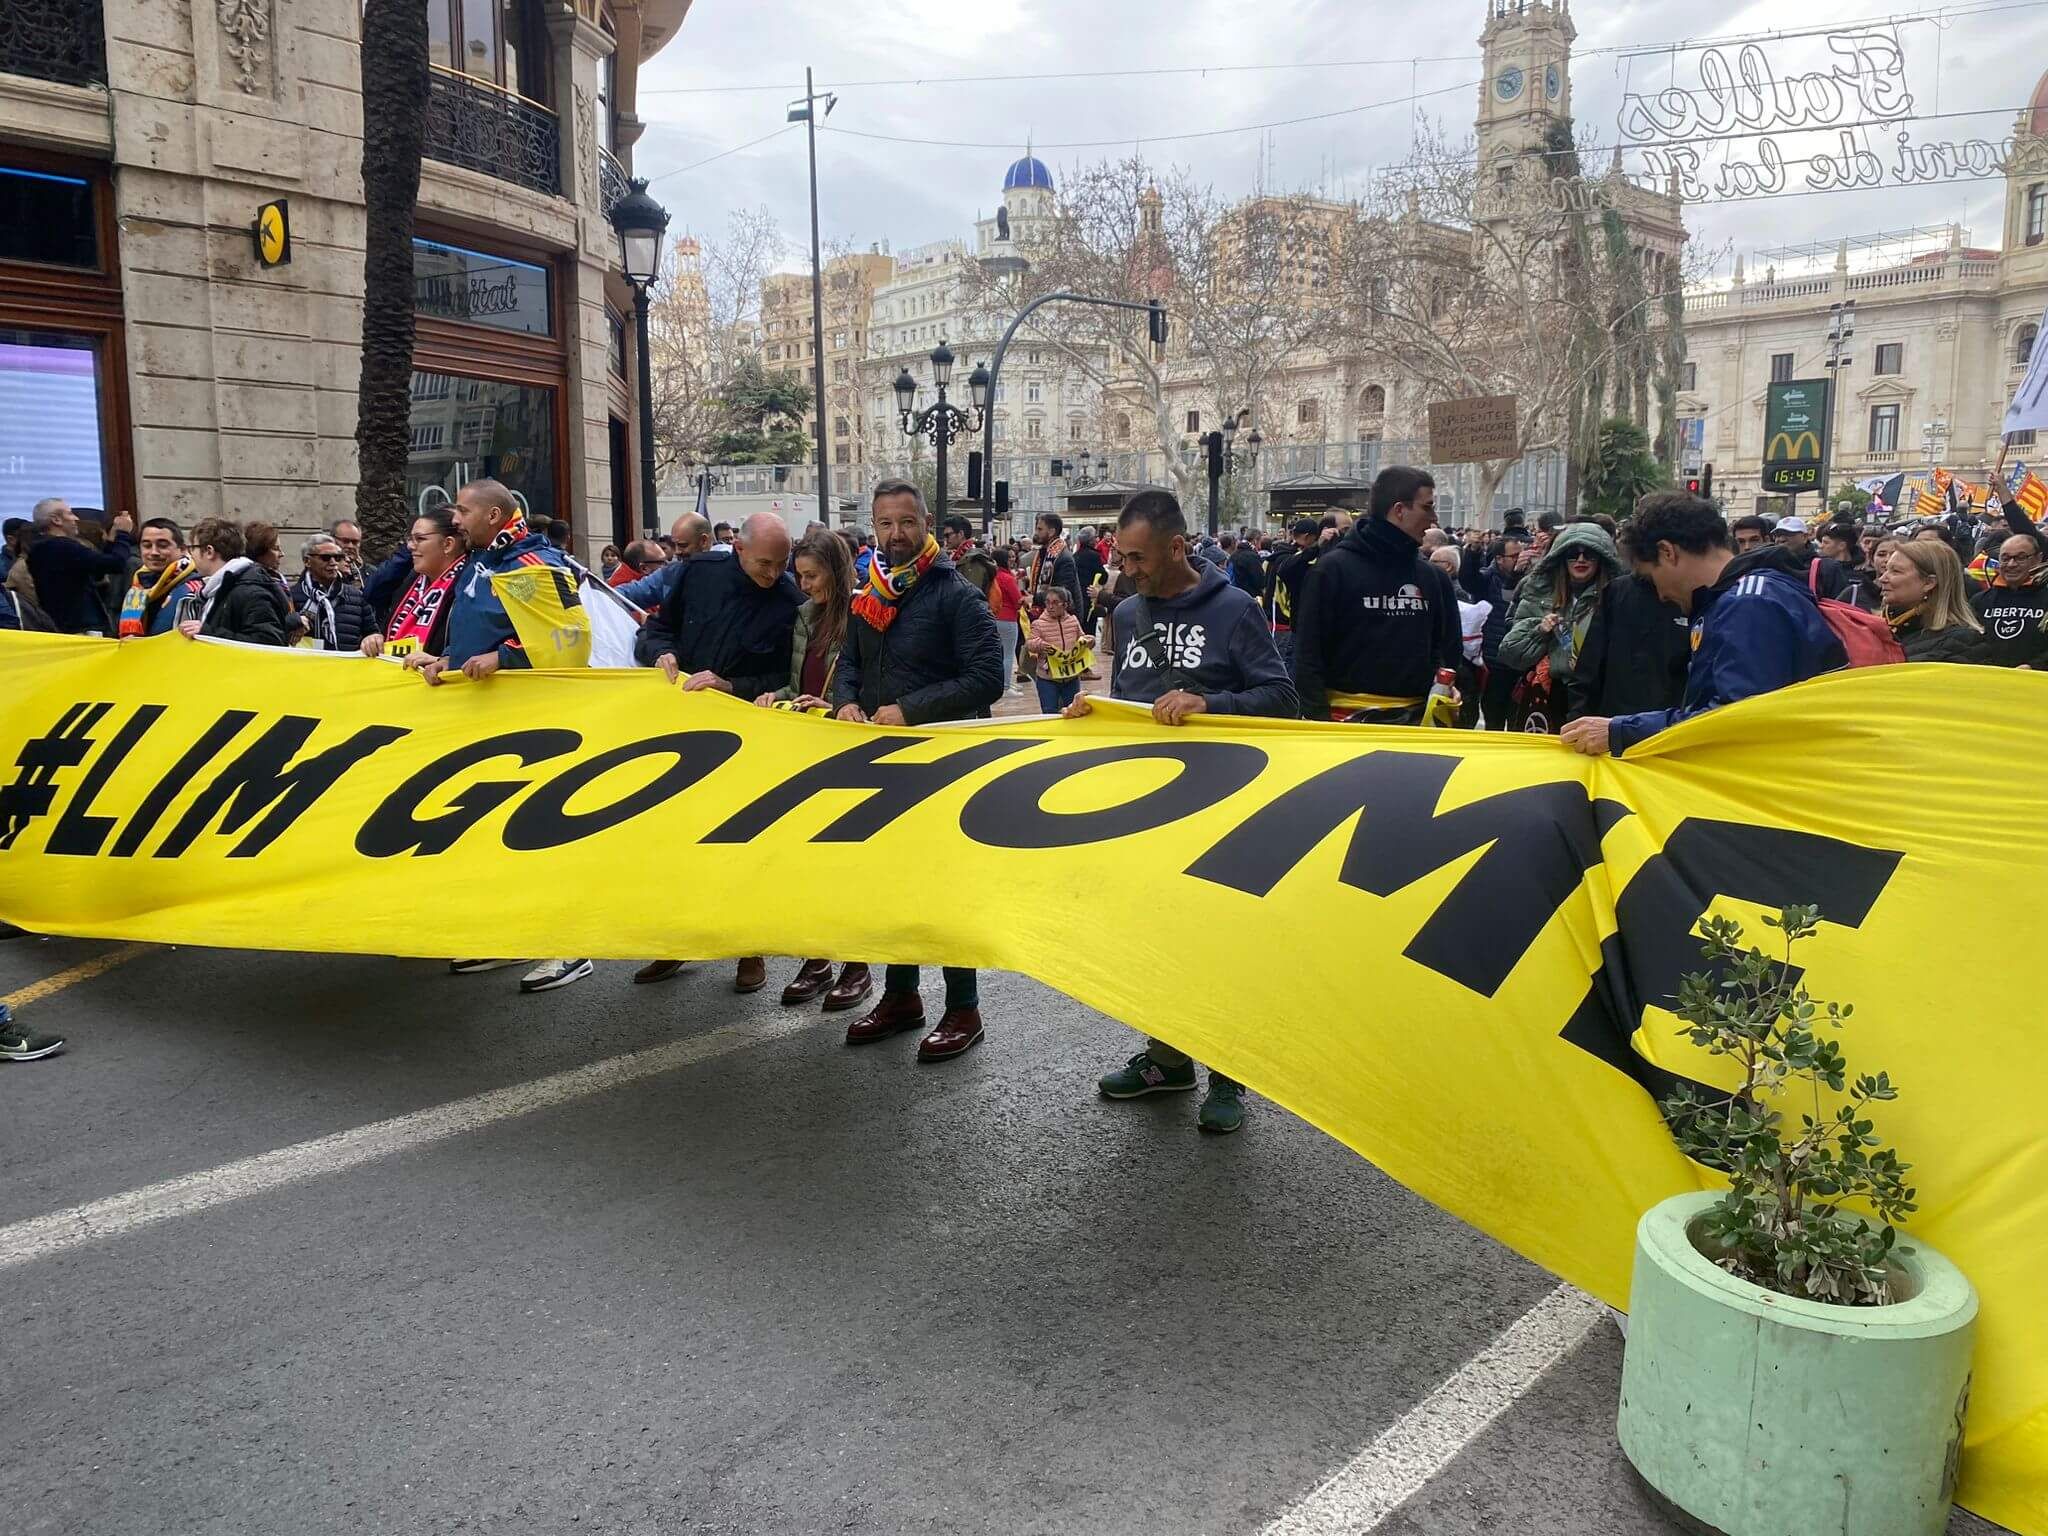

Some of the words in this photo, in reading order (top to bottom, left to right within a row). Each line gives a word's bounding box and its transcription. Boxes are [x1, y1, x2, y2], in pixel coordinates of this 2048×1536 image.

[1774, 468, 1816, 483] 16:49
[1984, 607, 2044, 618] LIBERTAD
[0, 702, 413, 858] #LIM
[354, 728, 743, 858] GO
[697, 736, 1907, 1136] HOME
